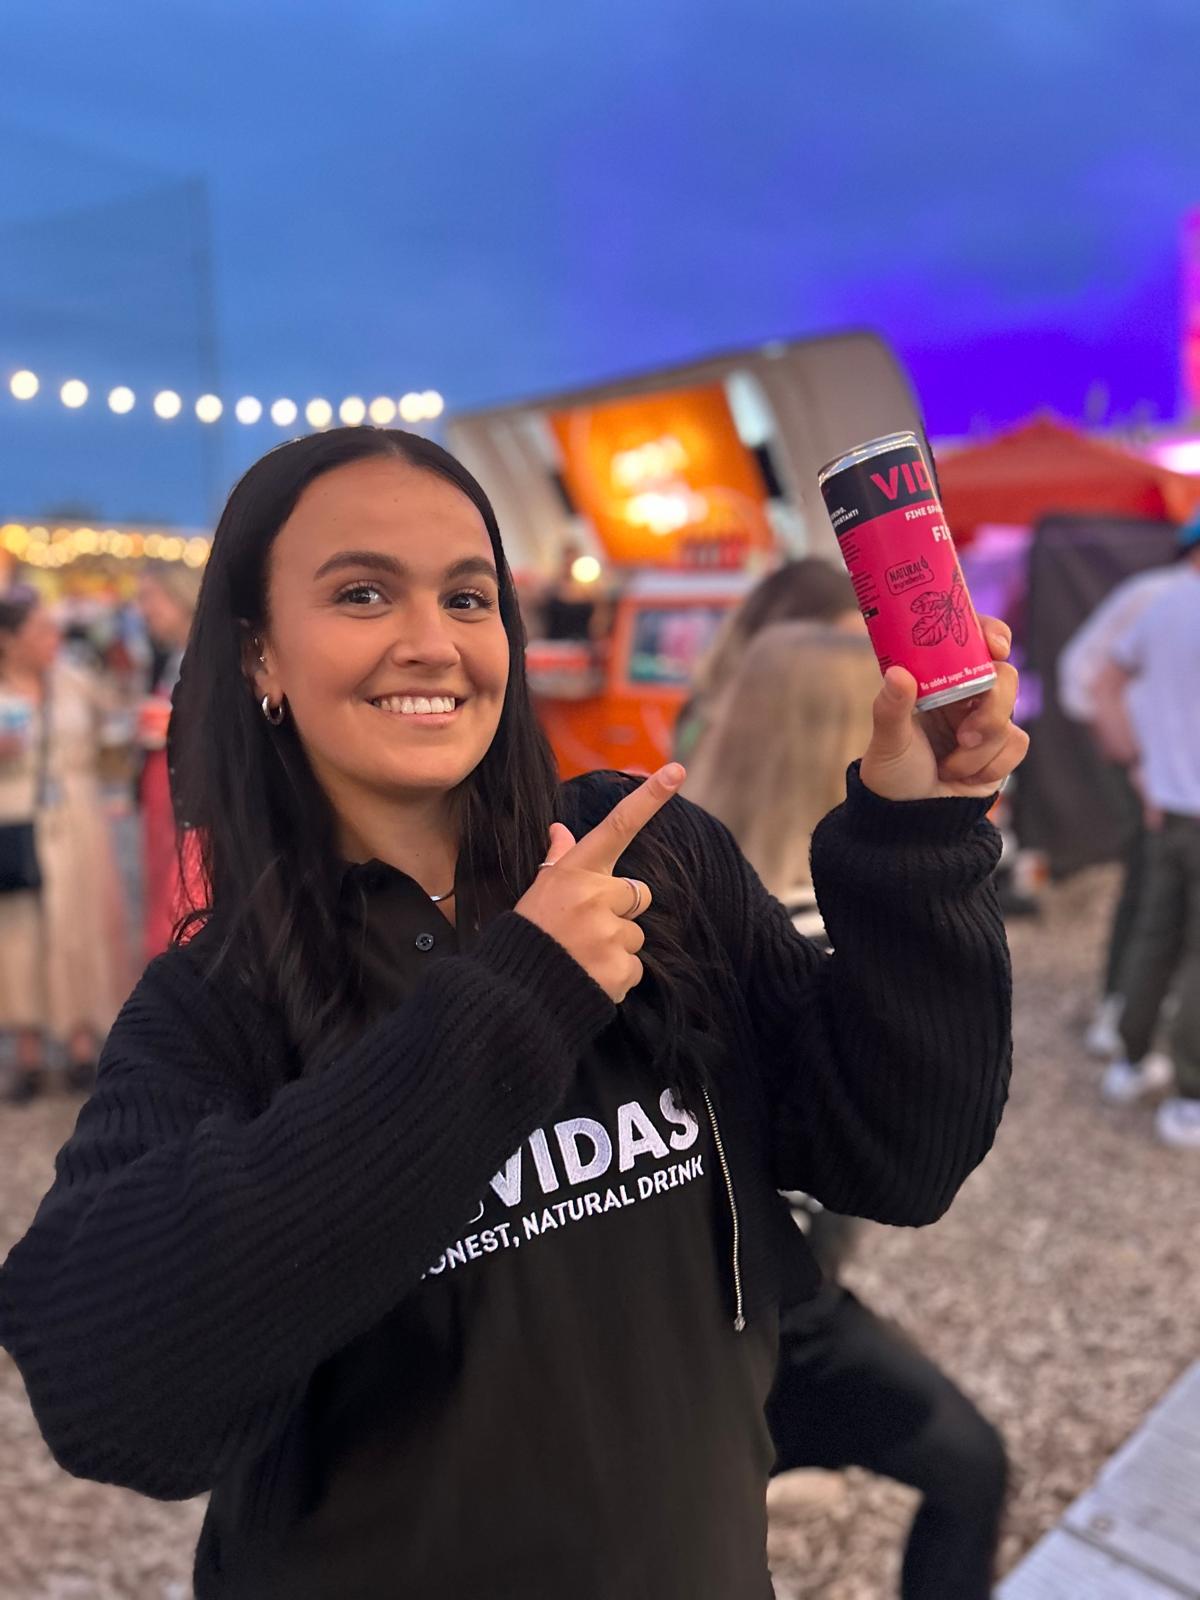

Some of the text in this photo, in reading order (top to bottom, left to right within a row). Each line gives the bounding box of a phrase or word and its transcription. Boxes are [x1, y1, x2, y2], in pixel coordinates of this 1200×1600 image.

[905, 506, 927, 521] FINE
[889, 561, 922, 583] NATURAL
[420, 1154, 704, 1280] ONEST, NATURAL DRINK
